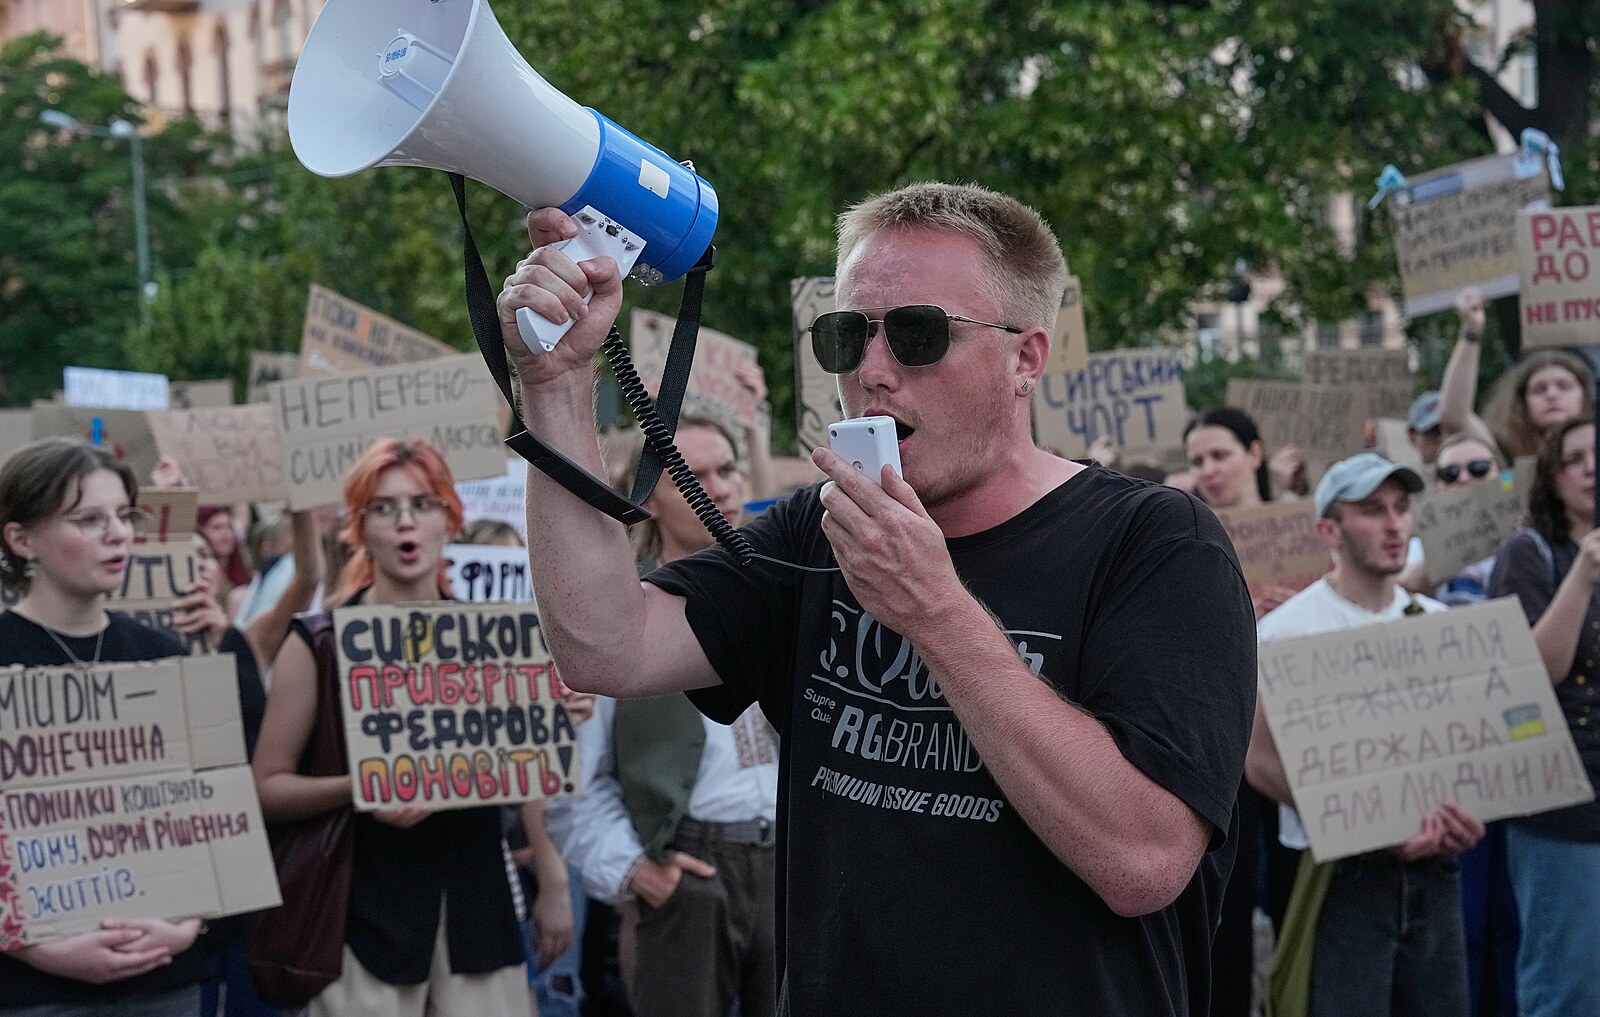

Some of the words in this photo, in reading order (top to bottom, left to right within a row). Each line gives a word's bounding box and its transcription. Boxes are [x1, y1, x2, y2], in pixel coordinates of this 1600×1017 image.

[1532, 250, 1590, 284] ДО
[1526, 302, 1558, 324] НЕ
[341, 612, 550, 664] СИРСЬКОГ
[1309, 633, 1427, 682] ЛЮДИНА
[1436, 618, 1508, 662] ДЛЯ
[362, 703, 575, 752] ФЕДОРОВА
[1282, 674, 1455, 738] ДЕРЖАВИ
[359, 746, 574, 802] ПОНОВІТЬ!
[1298, 715, 1503, 786] ДЕРЖАВА
[6, 784, 116, 830] ПОМИЛКИ
[811, 766, 885, 807] PREMIUM
[881, 785, 932, 813] ISSUE
[931, 793, 1003, 822] GOODS
[1319, 784, 1385, 836] ДЛЯ
